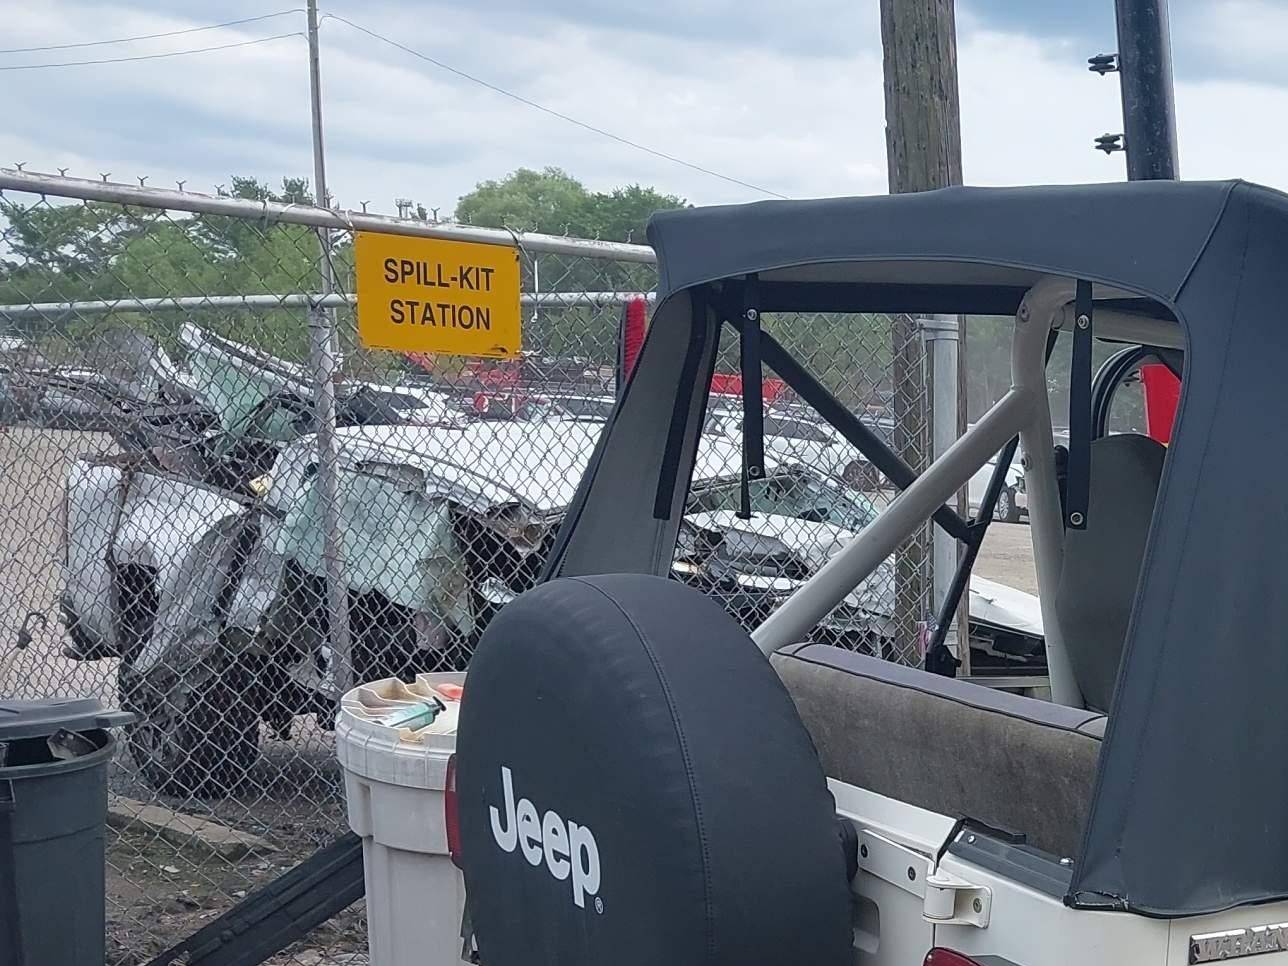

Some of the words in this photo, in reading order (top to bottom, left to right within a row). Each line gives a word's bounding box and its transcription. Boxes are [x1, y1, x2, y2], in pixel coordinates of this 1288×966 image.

[384, 257, 495, 291] SPILL-KIT
[390, 299, 491, 330] STATION
[489, 766, 601, 909] Jeep
